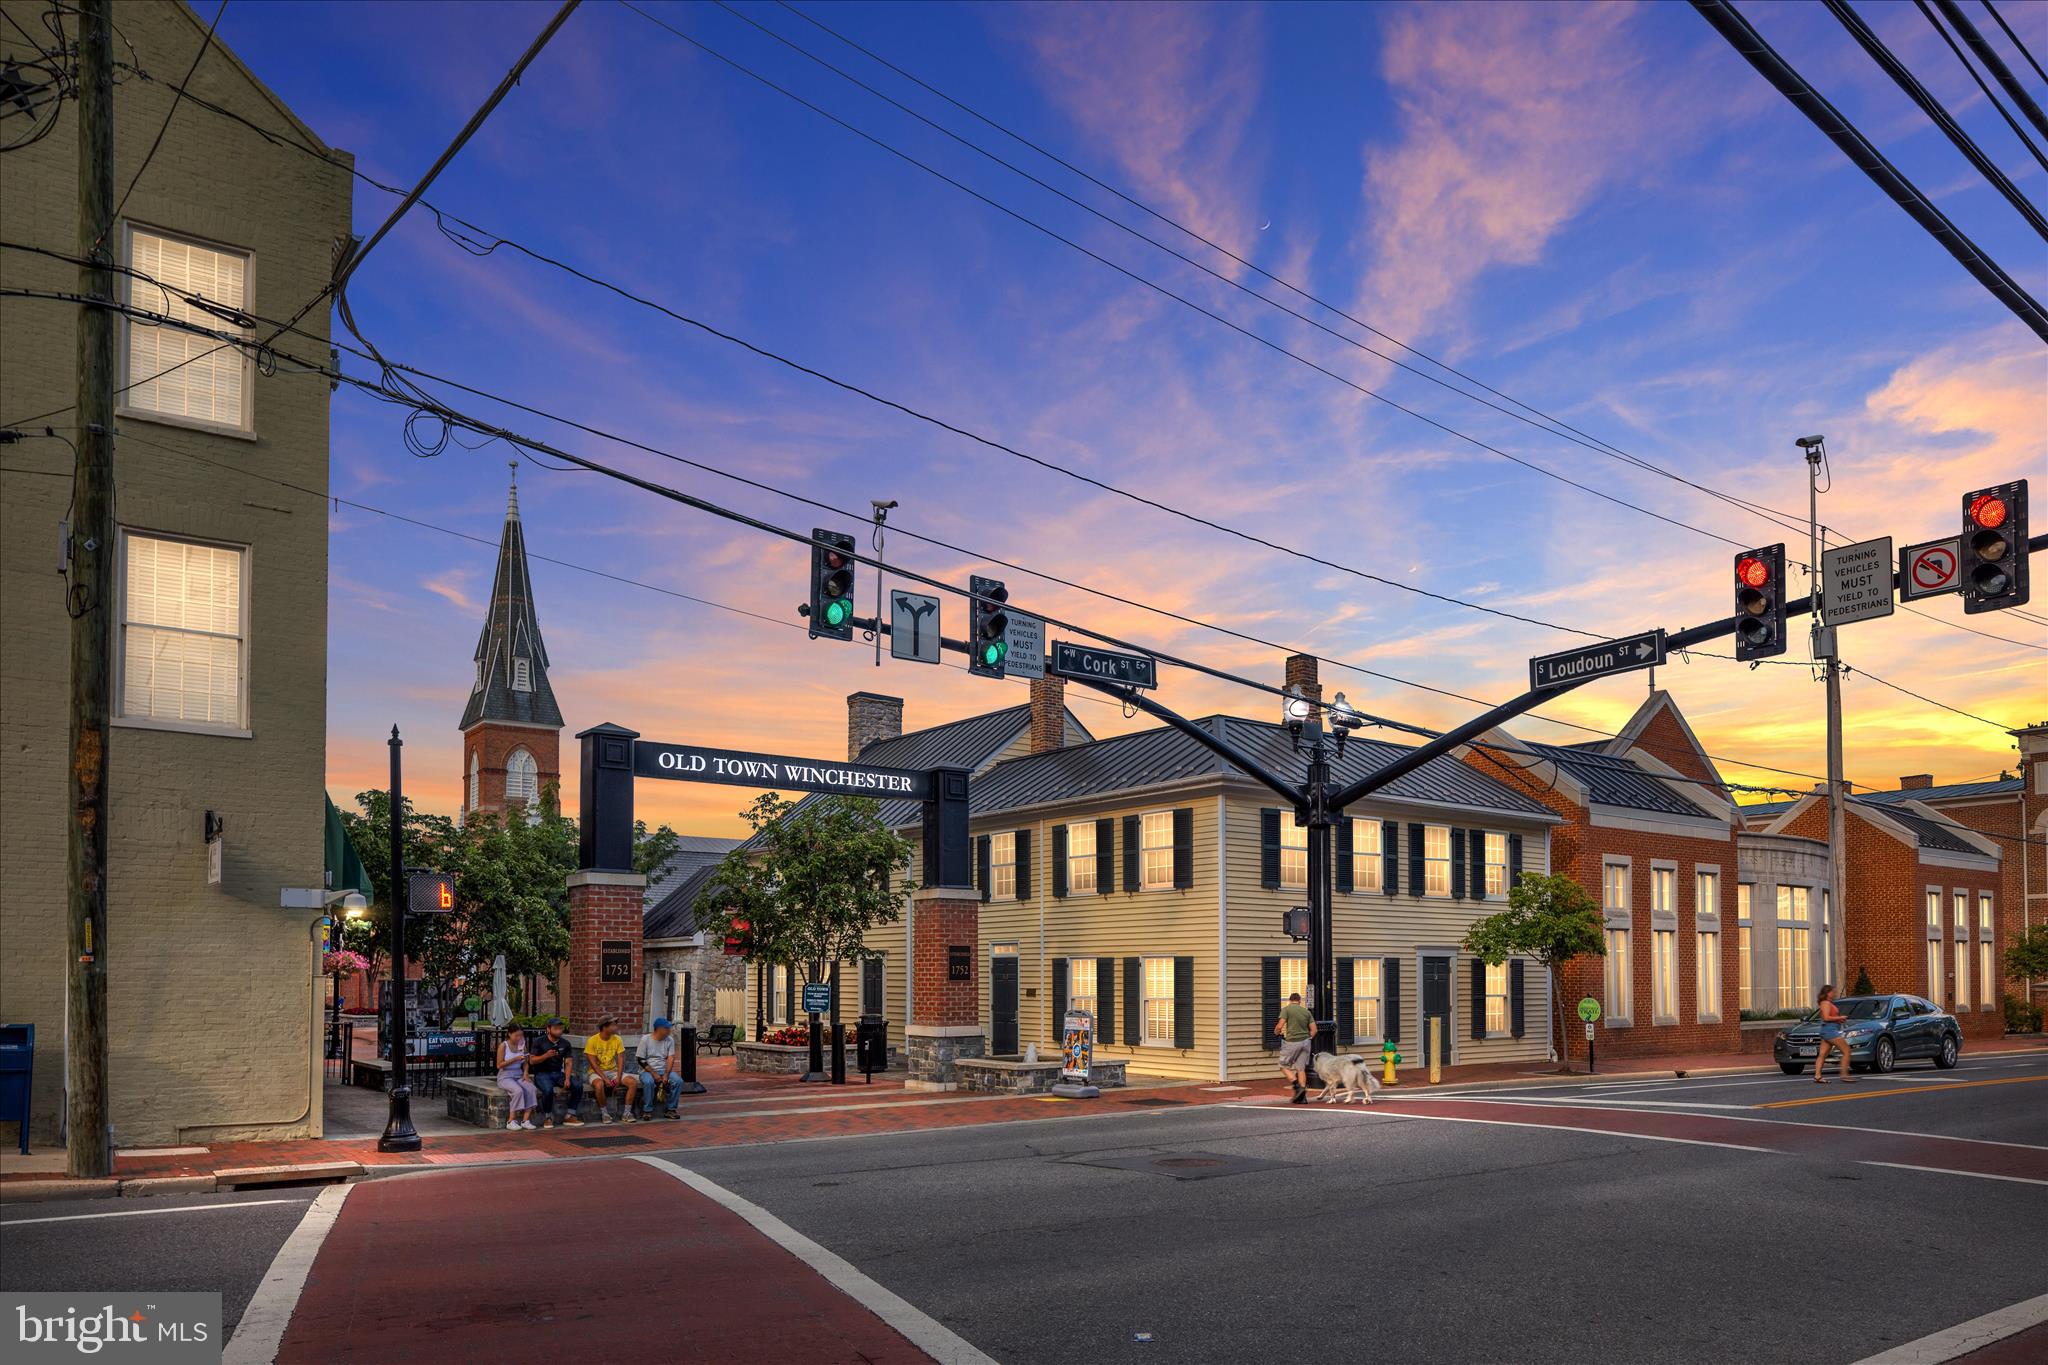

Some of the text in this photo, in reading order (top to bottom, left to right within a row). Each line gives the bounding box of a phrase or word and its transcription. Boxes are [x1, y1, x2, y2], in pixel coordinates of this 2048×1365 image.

[1837, 549, 1877, 564] TURNING
[1834, 561, 1880, 577] VEHICLES
[1841, 574, 1873, 590] MUST
[1837, 587, 1879, 603] YIELD TO
[1828, 598, 1889, 617] PEDESTRIANS
[1011, 618, 1037, 630] TURNING
[1009, 628, 1038, 640] VEHICLES
[1013, 639, 1033, 650] MUST
[1010, 651, 1037, 661] YIELD TO
[1538, 645, 1630, 680] S Loudoun ST
[1004, 659, 1043, 672] PEDESTRIANS
[1083, 654, 1116, 675] Cork
[1120, 660, 1130, 670] ST
[1135, 661, 1140, 670] E
[658, 752, 912, 792] OLD TOWN WINCHESTER
[606, 964, 629, 976] 1752
[951, 965, 969, 976] 1752
